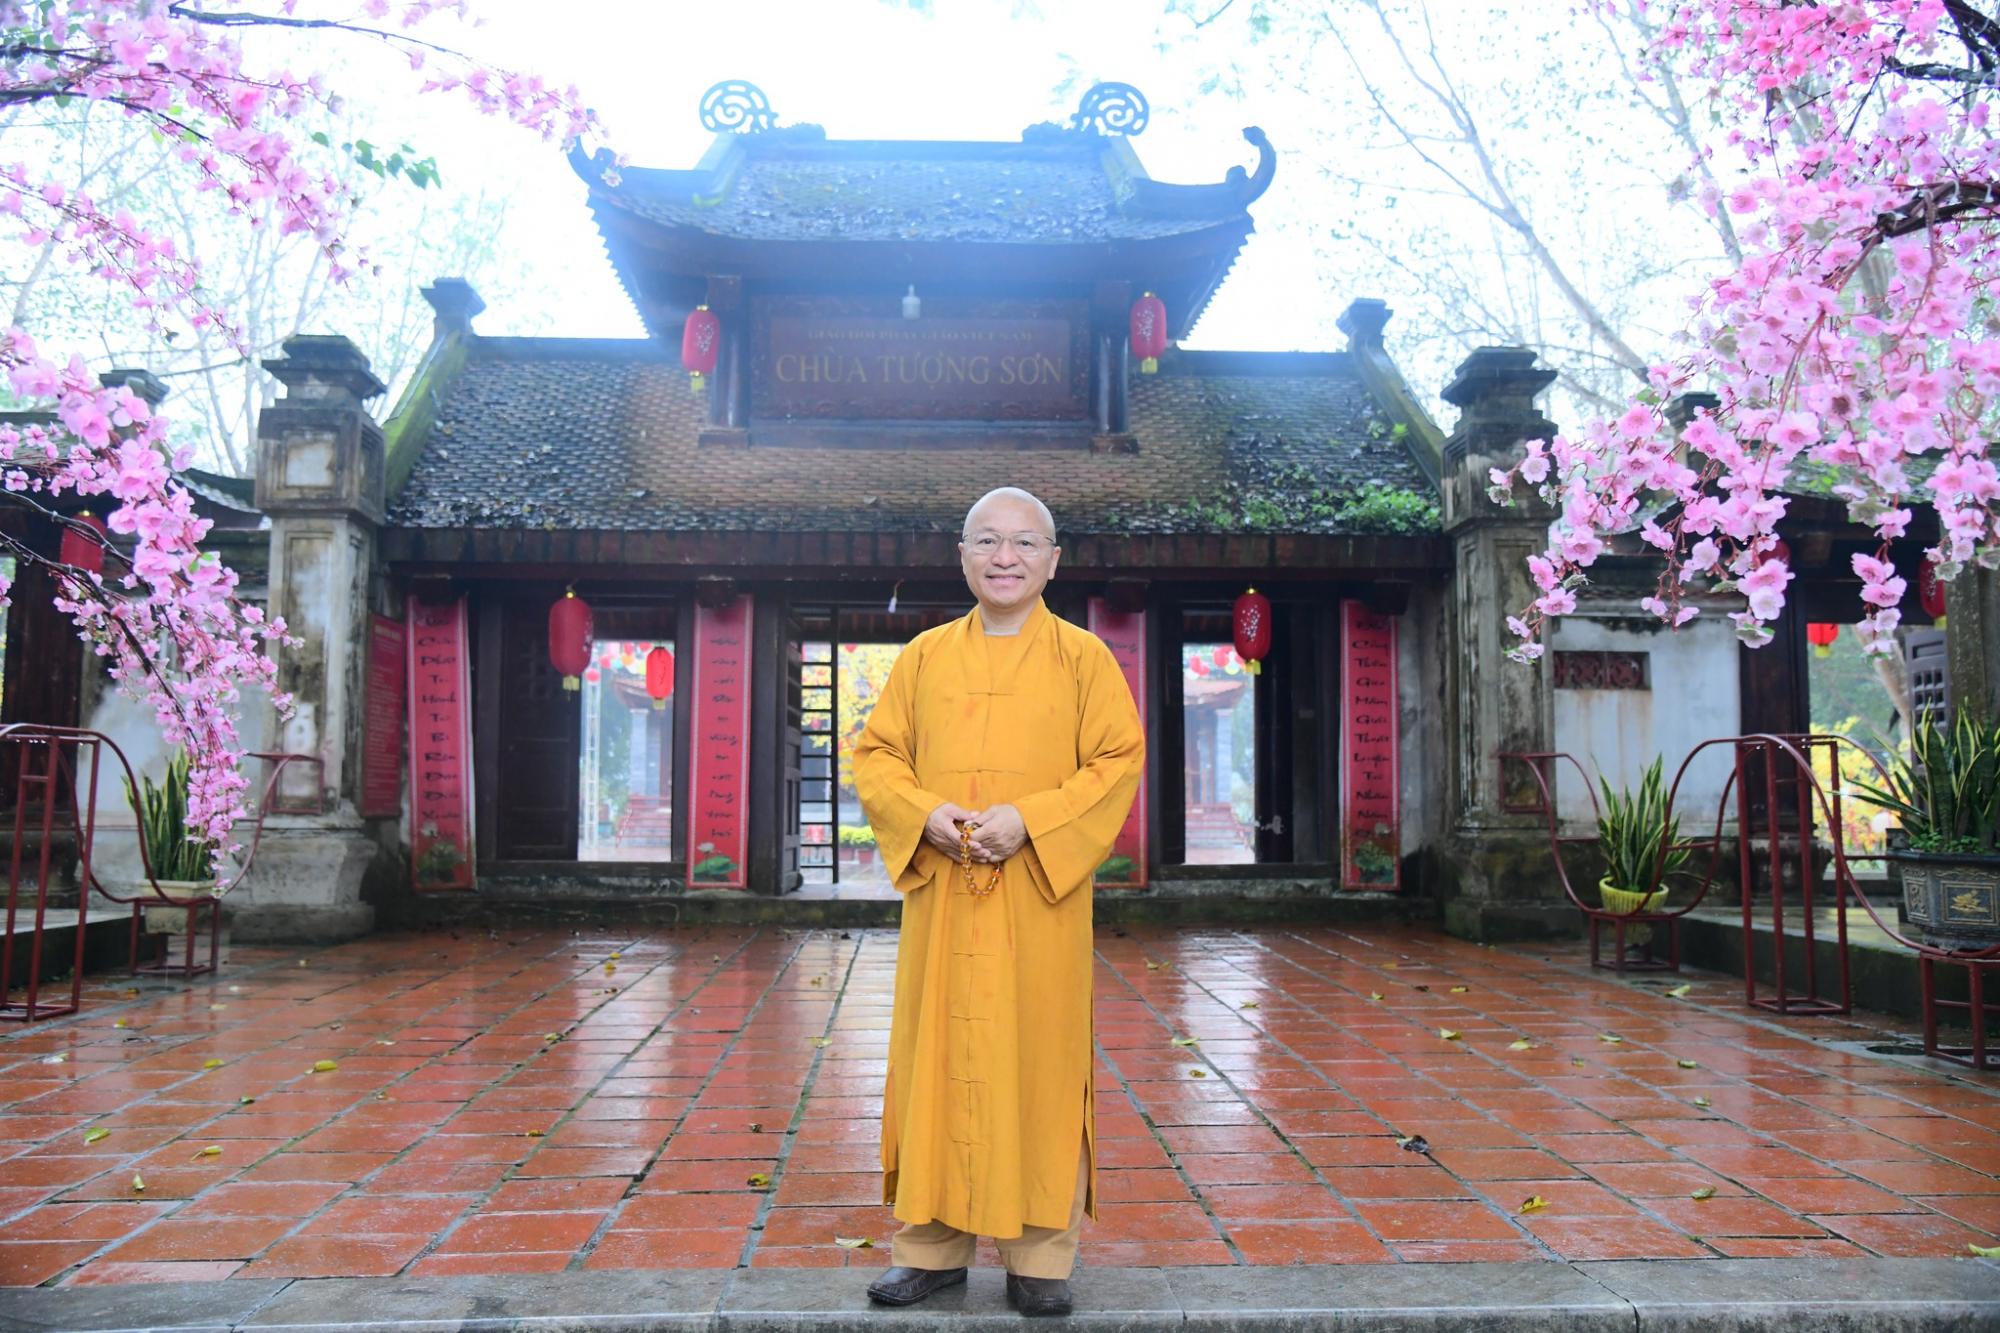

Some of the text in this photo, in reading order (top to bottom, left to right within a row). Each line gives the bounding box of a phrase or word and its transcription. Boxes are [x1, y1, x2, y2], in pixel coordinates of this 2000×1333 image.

[776, 347, 1063, 390] CHÙA TƯỢNG SƠN
